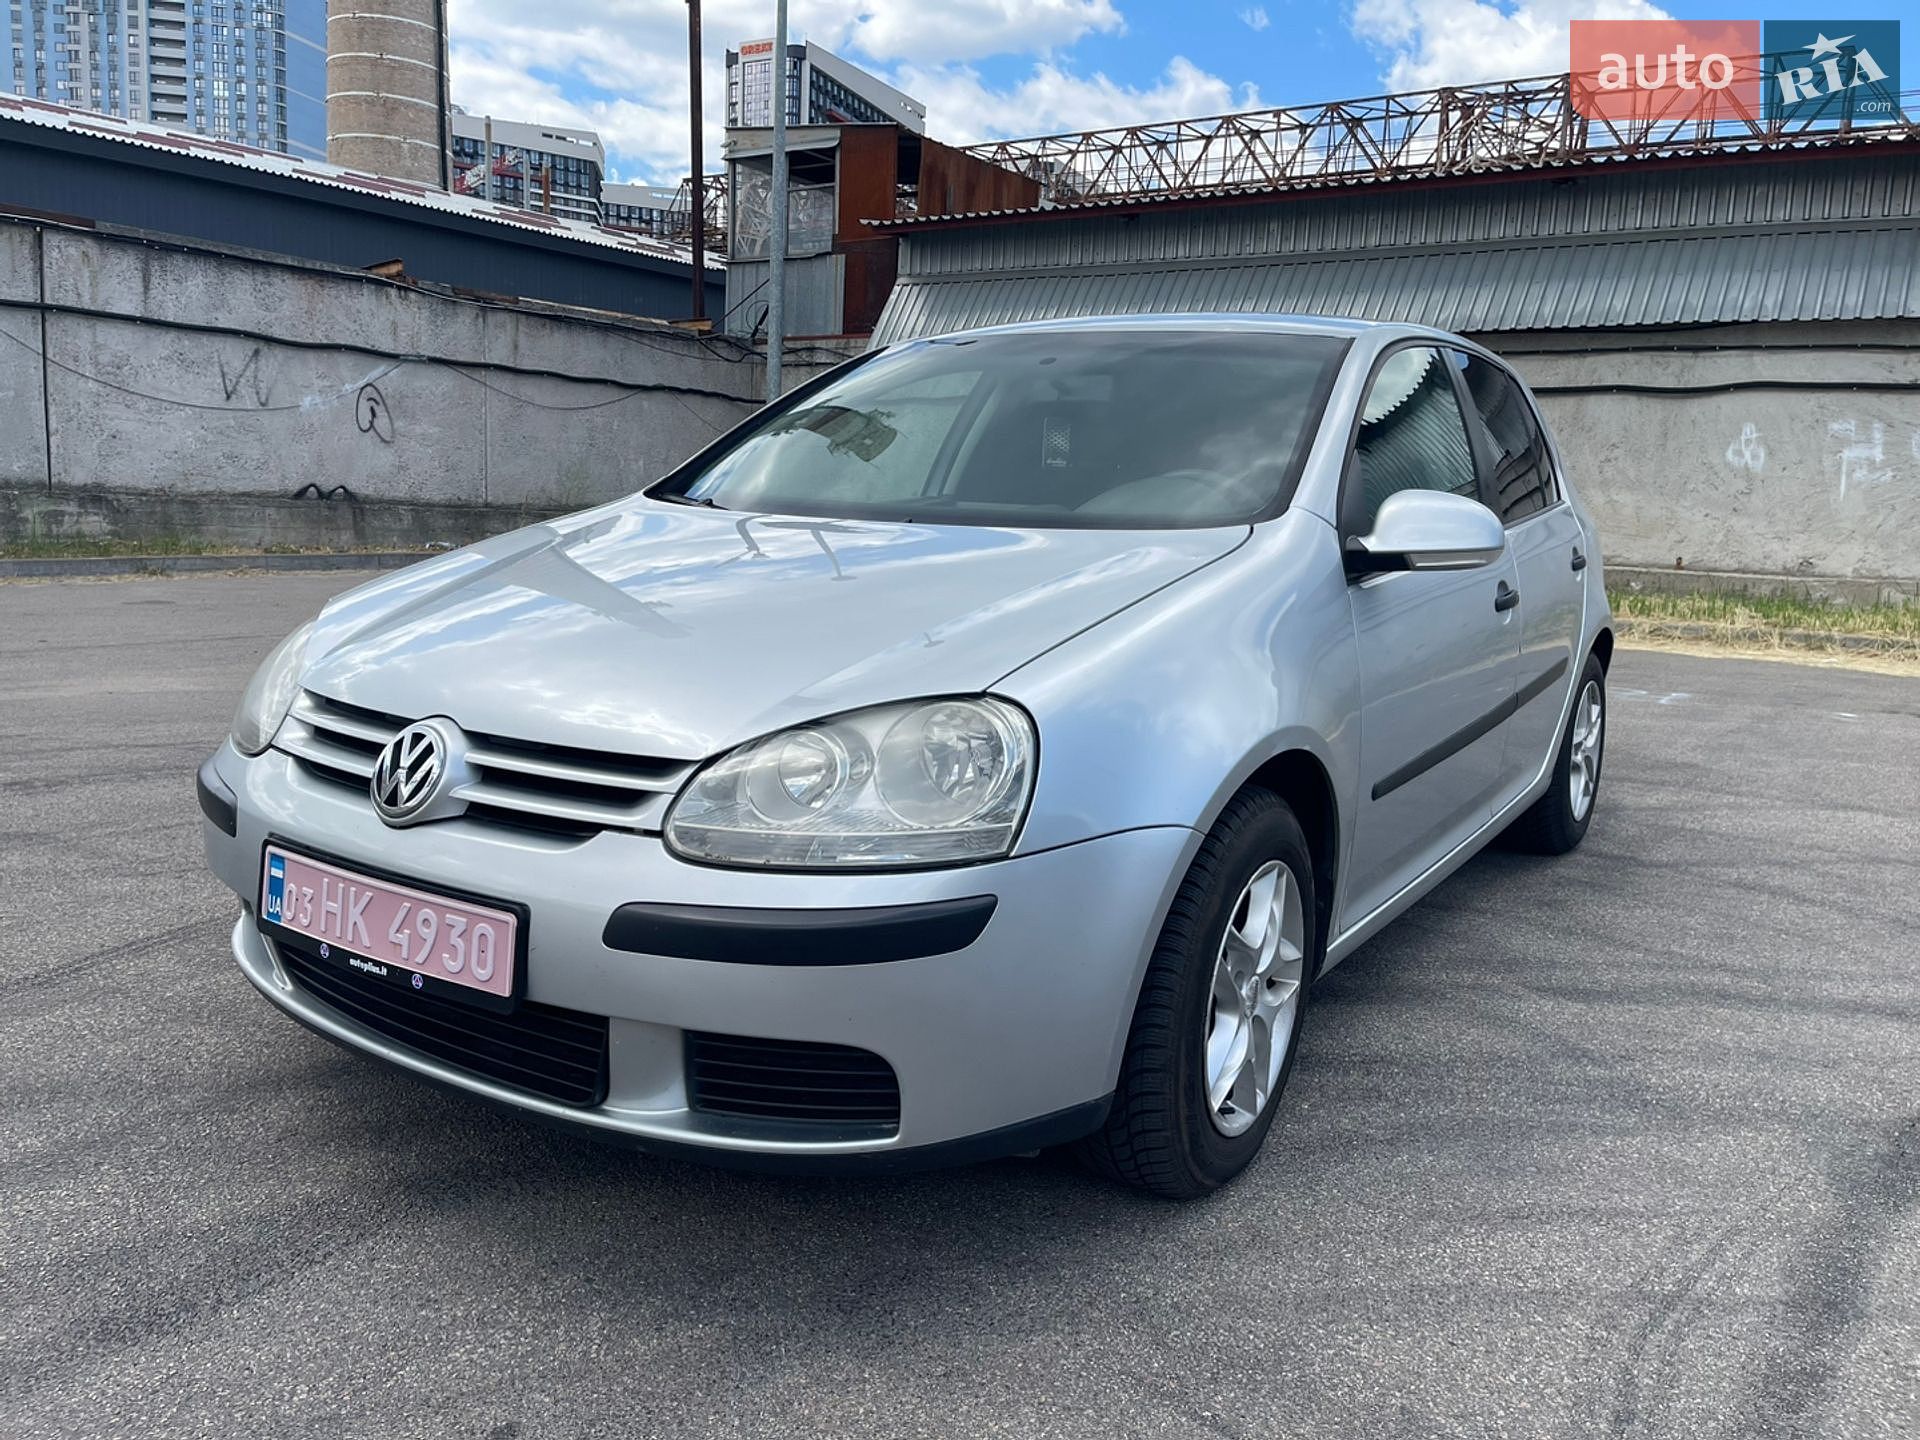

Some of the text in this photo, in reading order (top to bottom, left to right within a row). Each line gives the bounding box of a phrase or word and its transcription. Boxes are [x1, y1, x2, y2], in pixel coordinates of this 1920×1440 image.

[268, 894, 281, 915] UA
[284, 878, 496, 982] 03 HK 4930
